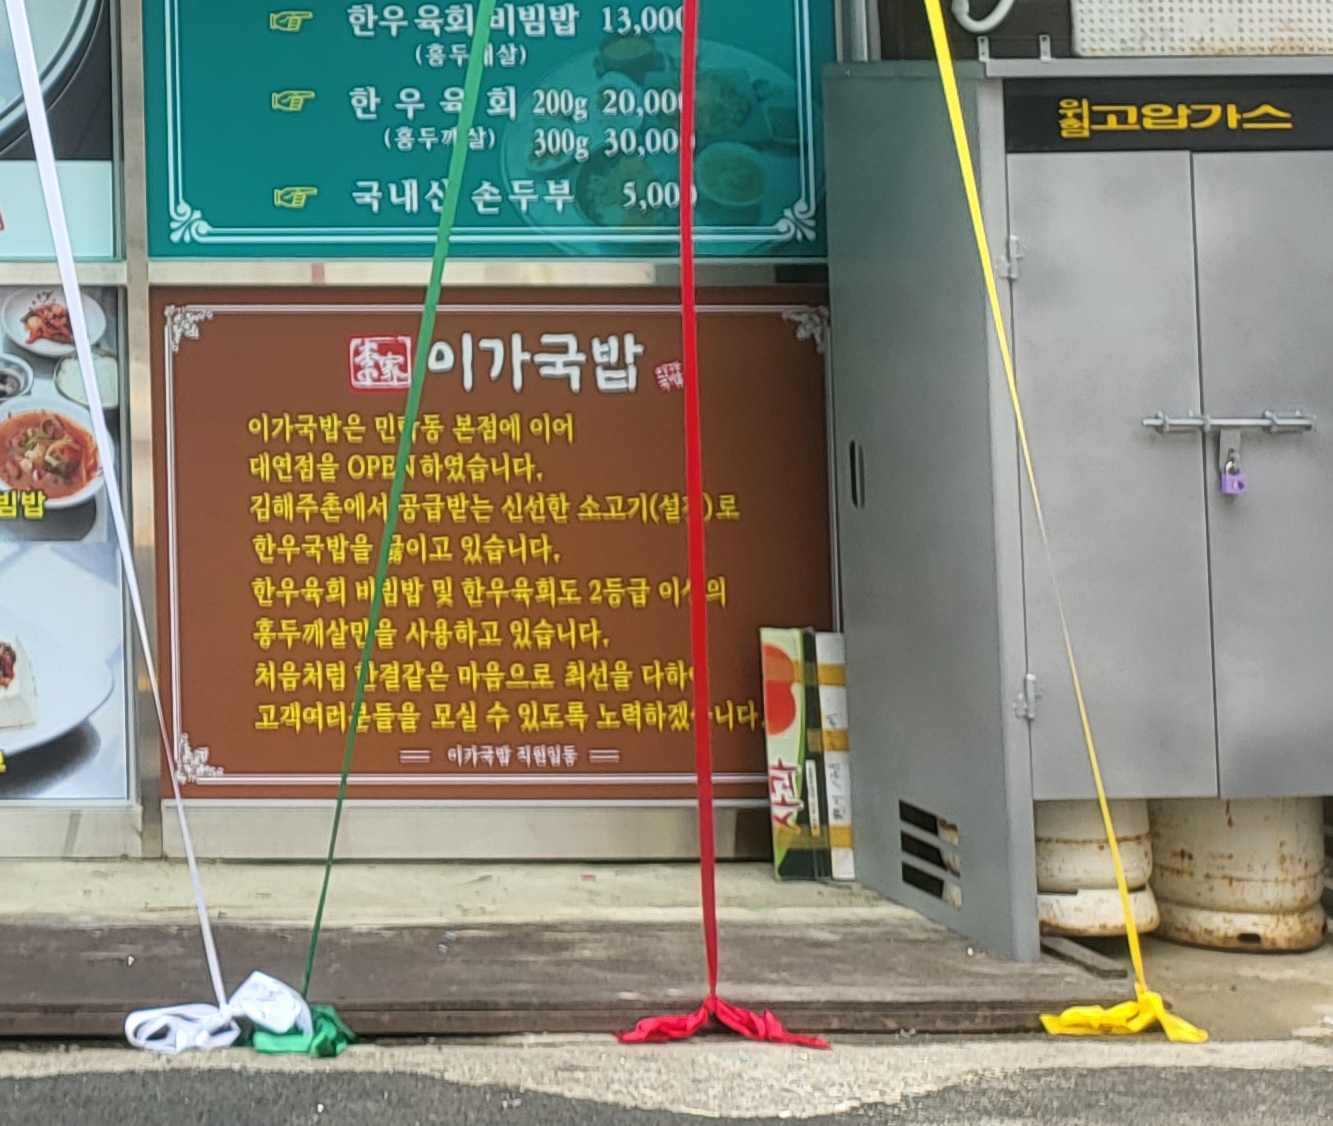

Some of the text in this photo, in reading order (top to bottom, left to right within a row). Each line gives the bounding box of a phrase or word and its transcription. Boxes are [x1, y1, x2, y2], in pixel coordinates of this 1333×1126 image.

[346, 3, 409, 38] 한우
[531, 88, 589, 123] 200g
[1058, 97, 1294, 139] 위험 고압가스
[533, 127, 590, 162] 300g
[427, 331, 645, 394] 이가국밥
[247, 412, 367, 445] 이가국밥은
[451, 412, 522, 445] 본점에
[529, 412, 575, 445] 이어
[248, 451, 341, 484] 대연점을
[249, 491, 389, 524] 김해주촌에서
[397, 492, 494, 524] 공급받는
[500, 491, 571, 524] 신선한
[252, 532, 373, 566] 한우국밥을
[460, 532, 562, 566] 있습니다.
[251, 575, 347, 609] 한우육회
[432, 576, 454, 608] 및
[461, 575, 583, 609] 한우육회도
[587, 576, 652, 608] 2등급
[253, 617, 611, 650] 홍두깨살만을 사용하고 있습니다.
[254, 659, 347, 693] 처음처럼
[457, 660, 556, 693] 마음으로
[563, 659, 633, 693] 최선을
[641, 659, 695, 693] 다하
[254, 701, 421, 735] 고객여러분들을
[430, 700, 478, 733] 모실
[485, 700, 510, 735] 수
[517, 700, 590, 734] 있도록
[446, 744, 513, 769] 이가국밥
